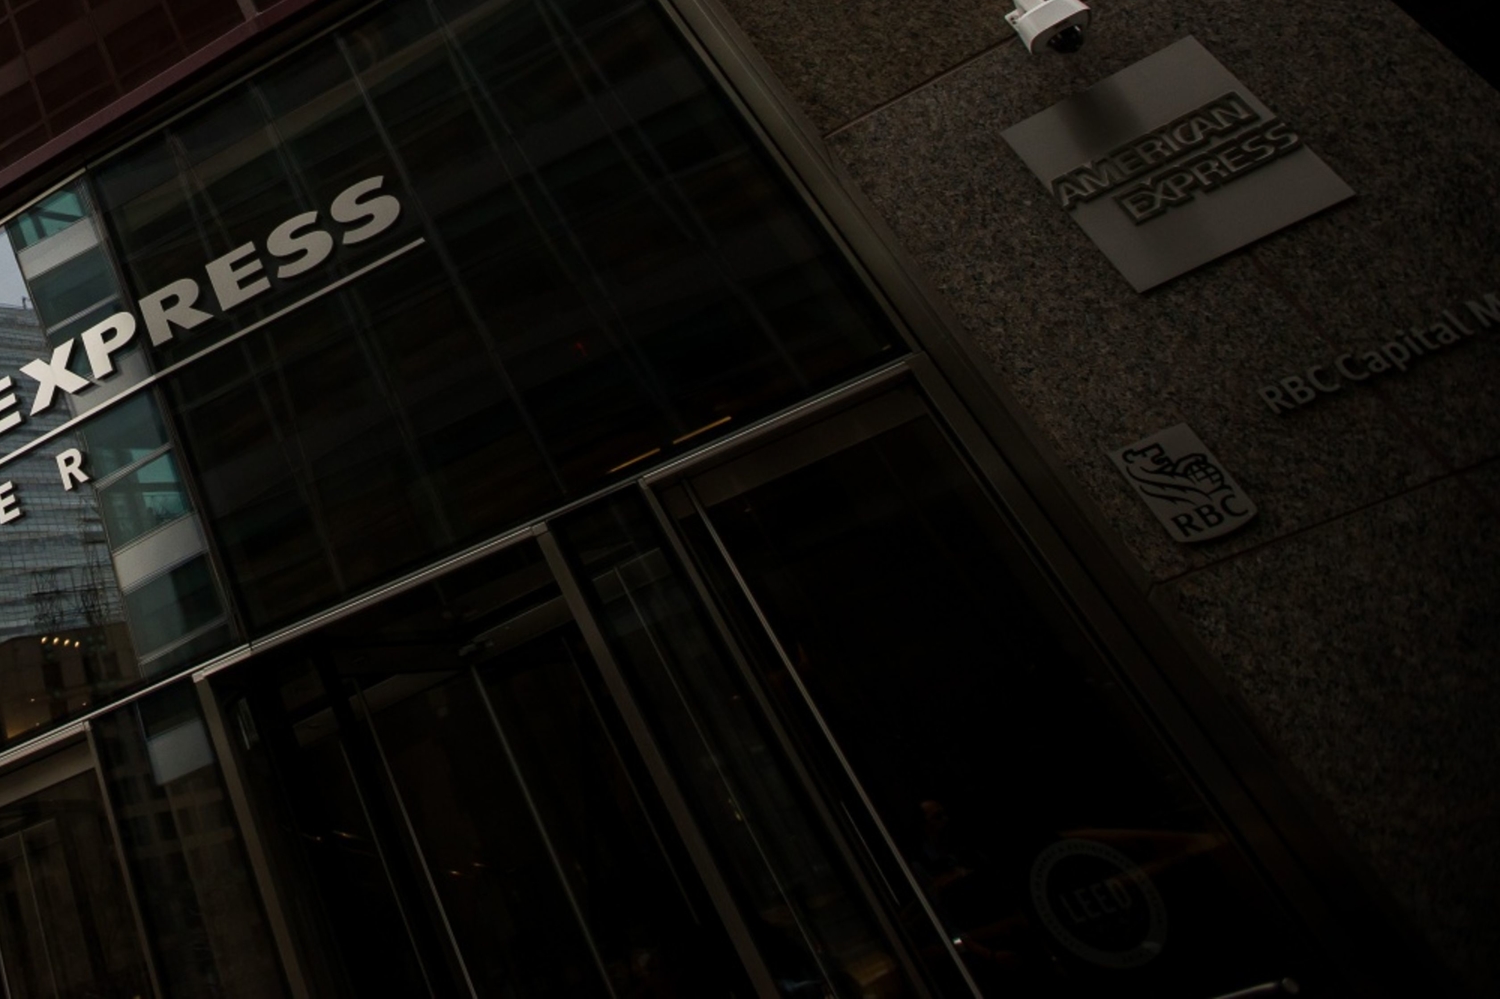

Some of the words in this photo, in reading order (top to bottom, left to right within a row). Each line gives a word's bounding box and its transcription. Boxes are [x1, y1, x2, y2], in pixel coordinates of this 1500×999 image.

[1055, 94, 1256, 209] AMERICAN
[1118, 120, 1302, 224] EXPRESS
[1259, 365, 1342, 414] RBC
[1334, 308, 1476, 380] Capital
[1171, 494, 1249, 537] RBC
[1058, 877, 1132, 924] LEED
